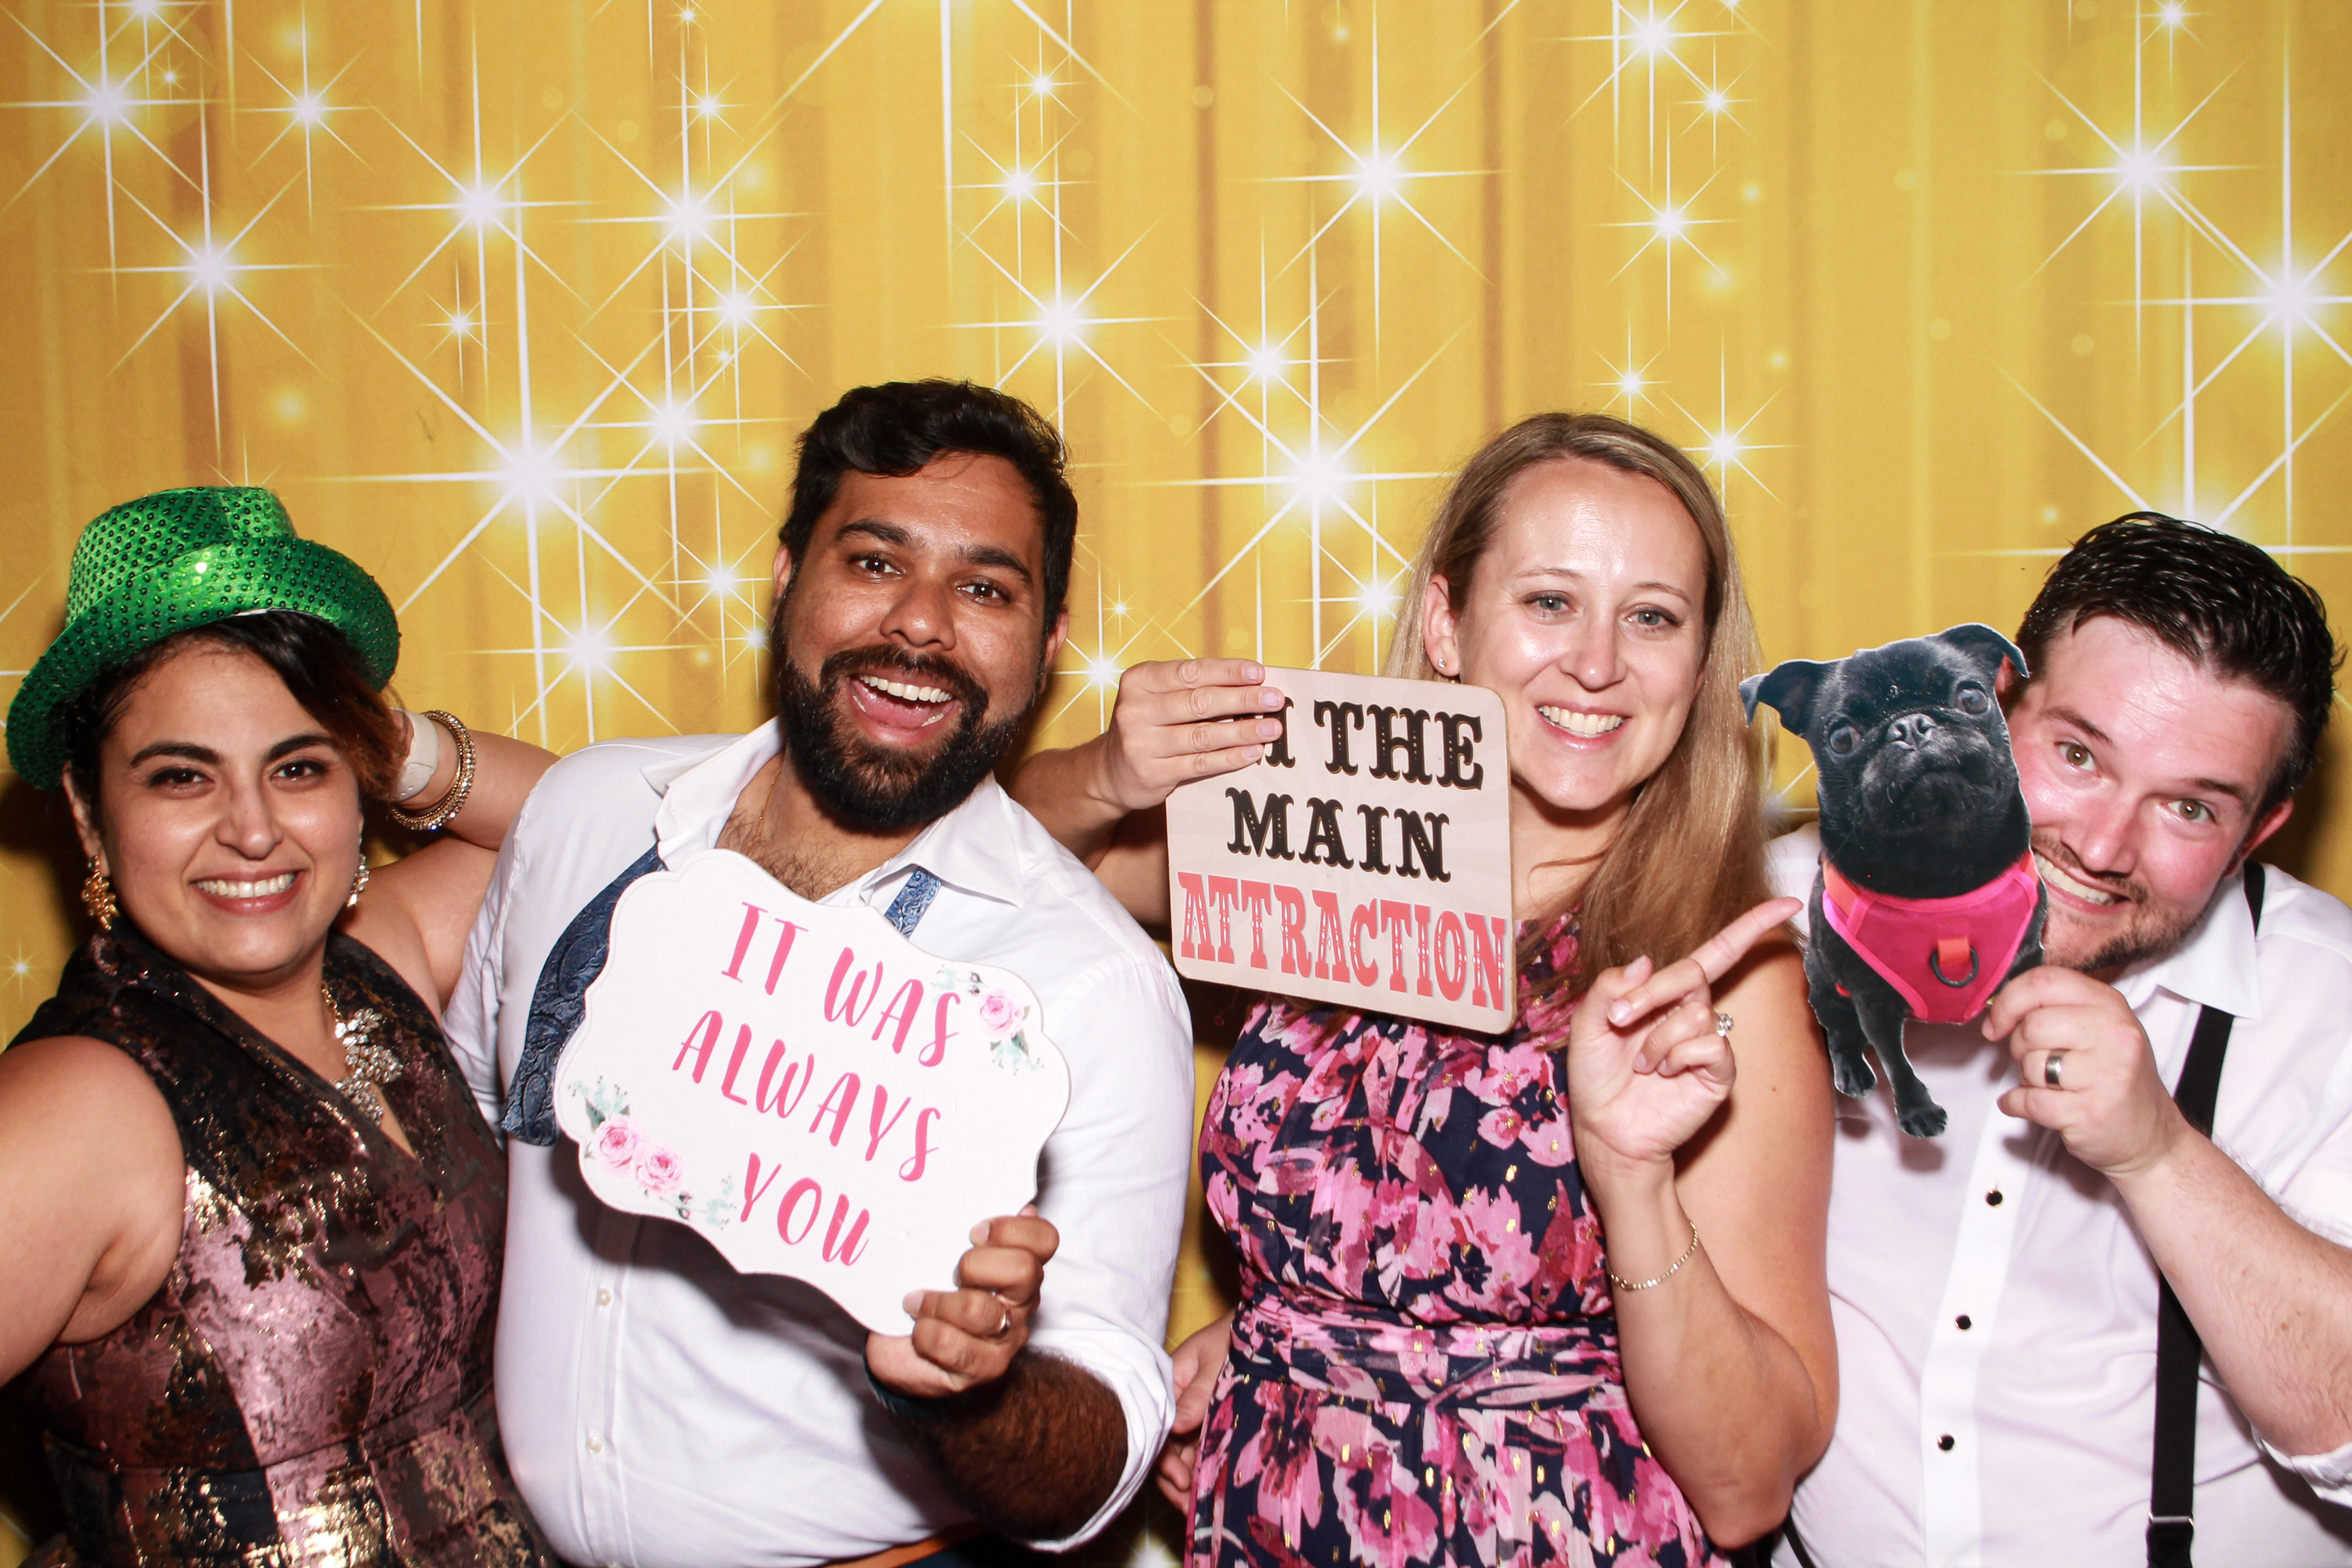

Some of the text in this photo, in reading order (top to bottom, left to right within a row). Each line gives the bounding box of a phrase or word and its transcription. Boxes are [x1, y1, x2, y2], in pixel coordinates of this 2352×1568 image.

[1314, 699, 1484, 791] THE
[1225, 787, 1451, 883] MAIN
[722, 902, 961, 1068] IT WAS
[1178, 872, 1506, 1011] ATTRACTION
[672, 1010, 941, 1182] ALWAYS
[740, 1152, 870, 1266] YOU
